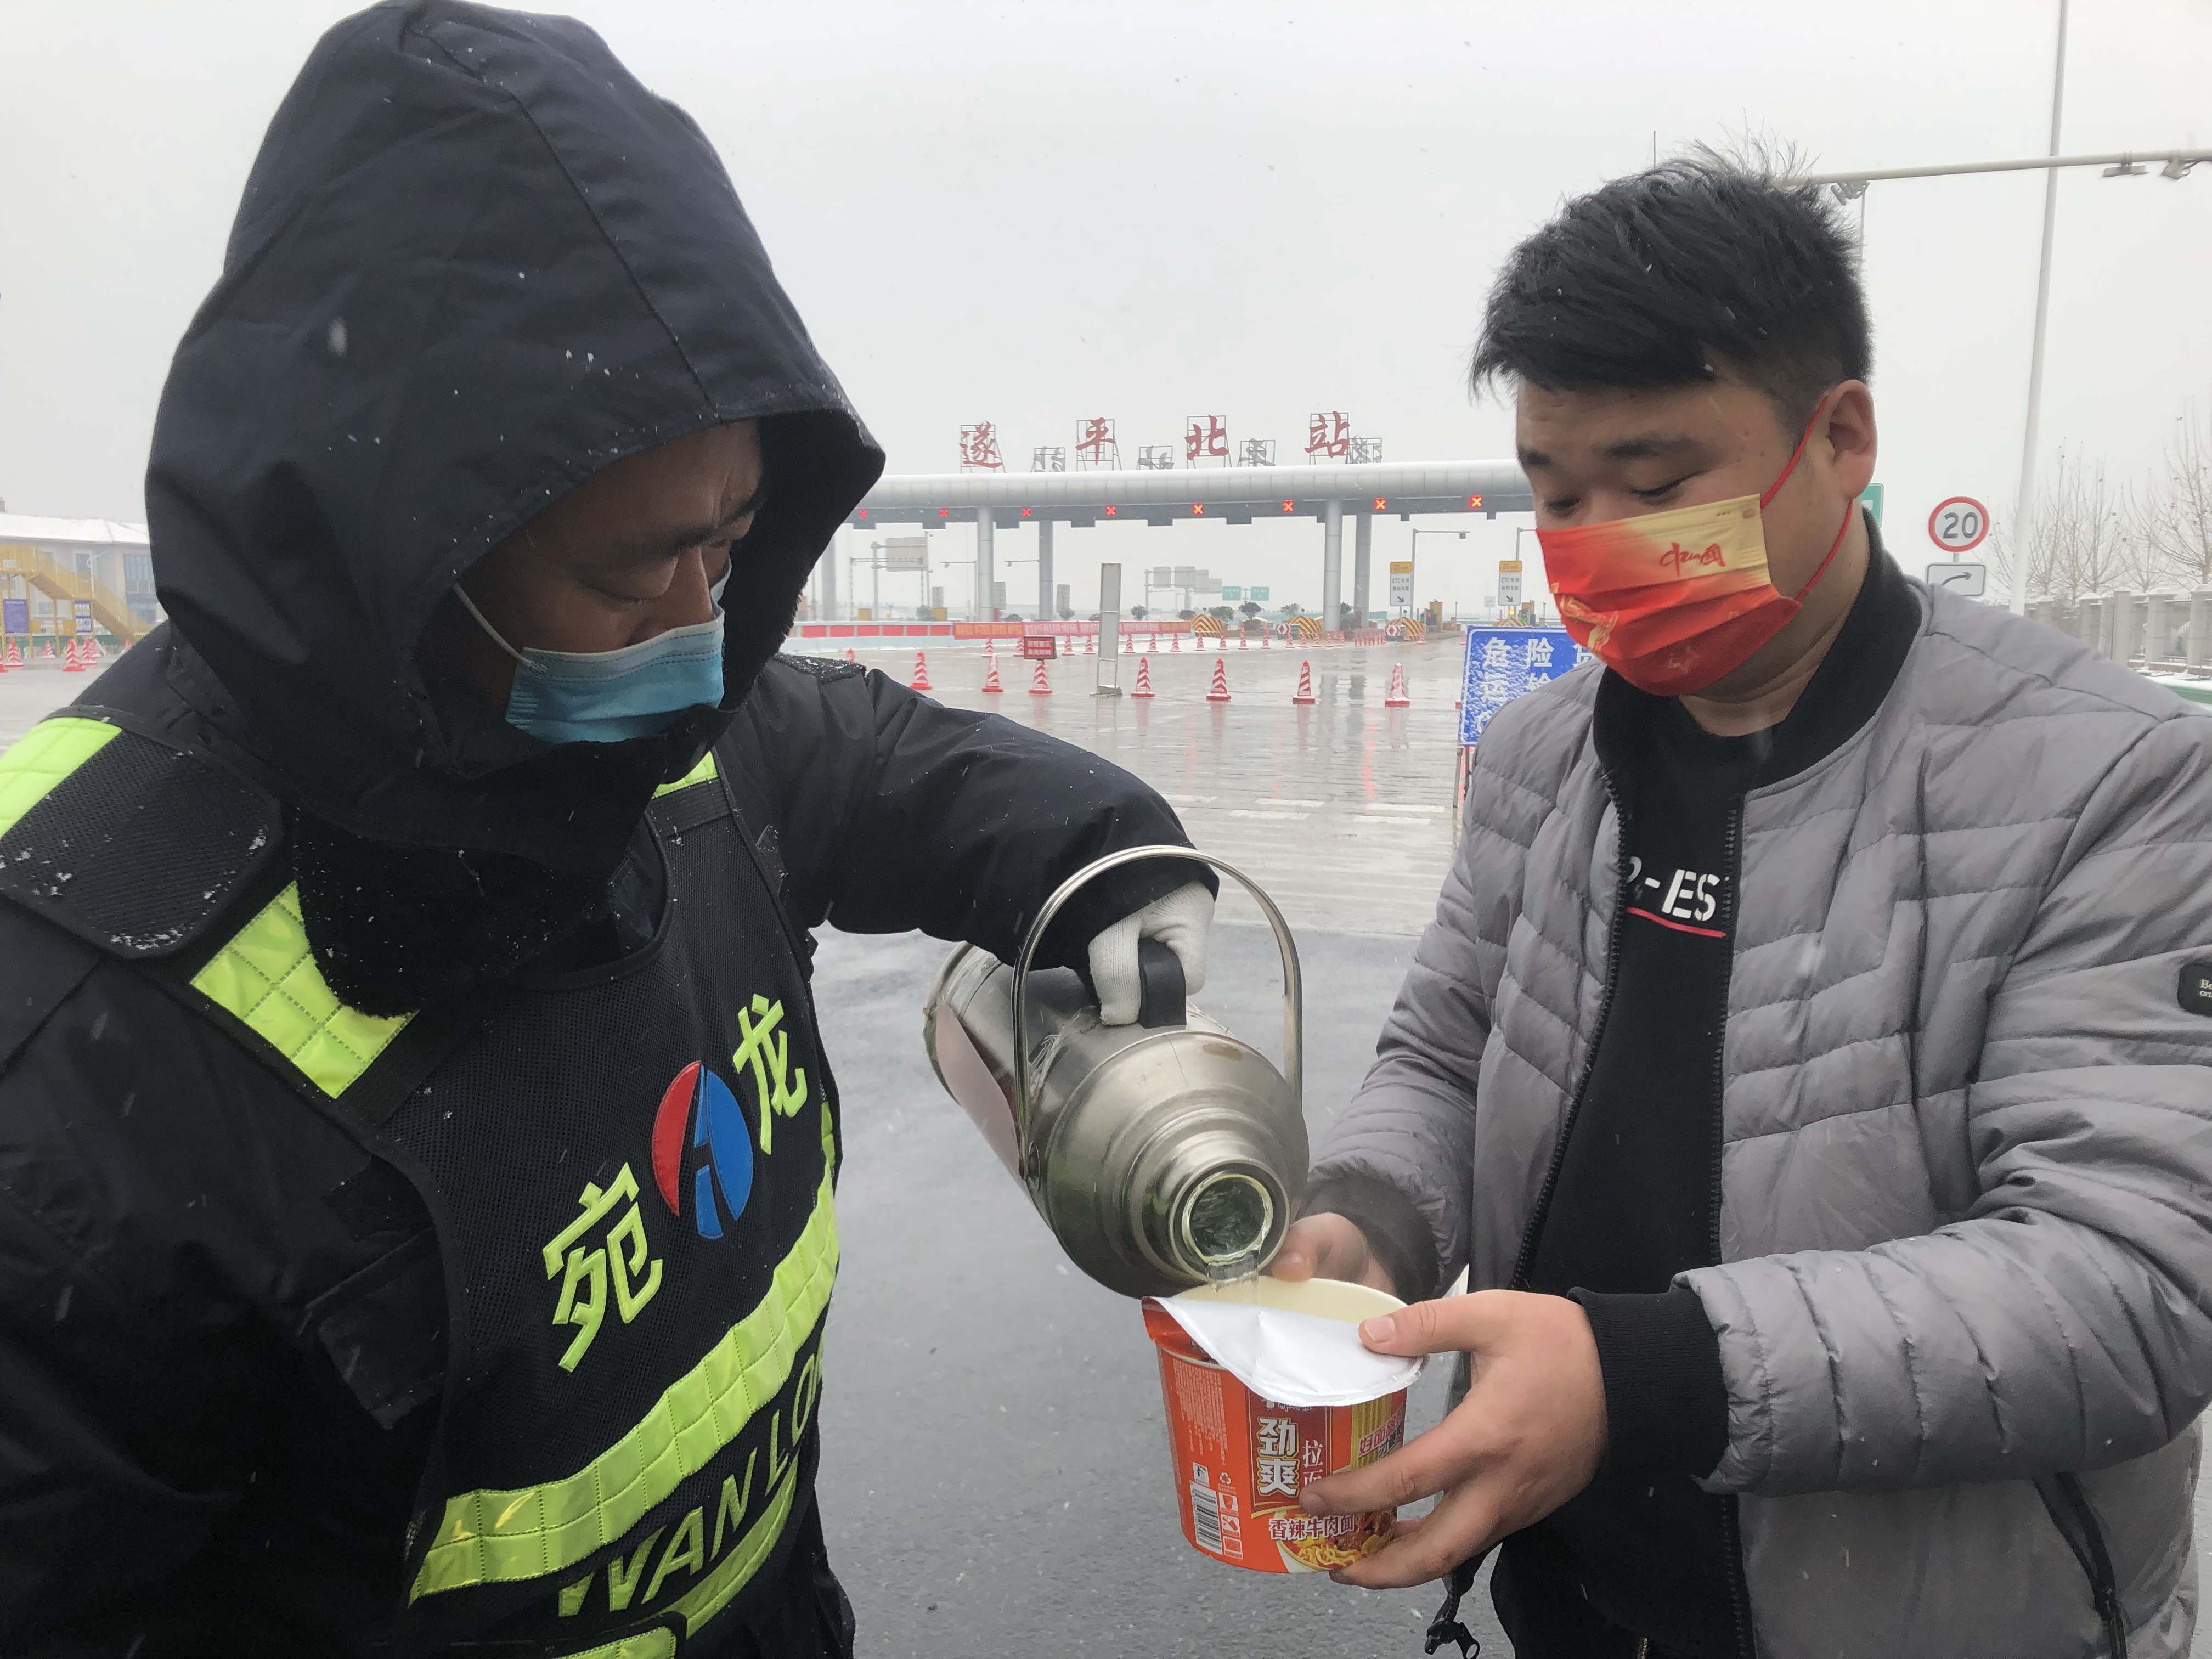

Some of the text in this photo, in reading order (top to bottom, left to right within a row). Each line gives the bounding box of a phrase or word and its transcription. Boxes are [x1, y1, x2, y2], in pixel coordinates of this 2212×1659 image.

[959, 410, 1350, 468] 遂平北站
[1943, 511, 1978, 539] 20
[543, 993, 808, 1373] 宛 龙
[558, 1328, 823, 1617] WANLO
[1258, 1417, 1297, 1497] 劲爽
[1269, 1514, 1354, 1539] 香辣牛肉面
